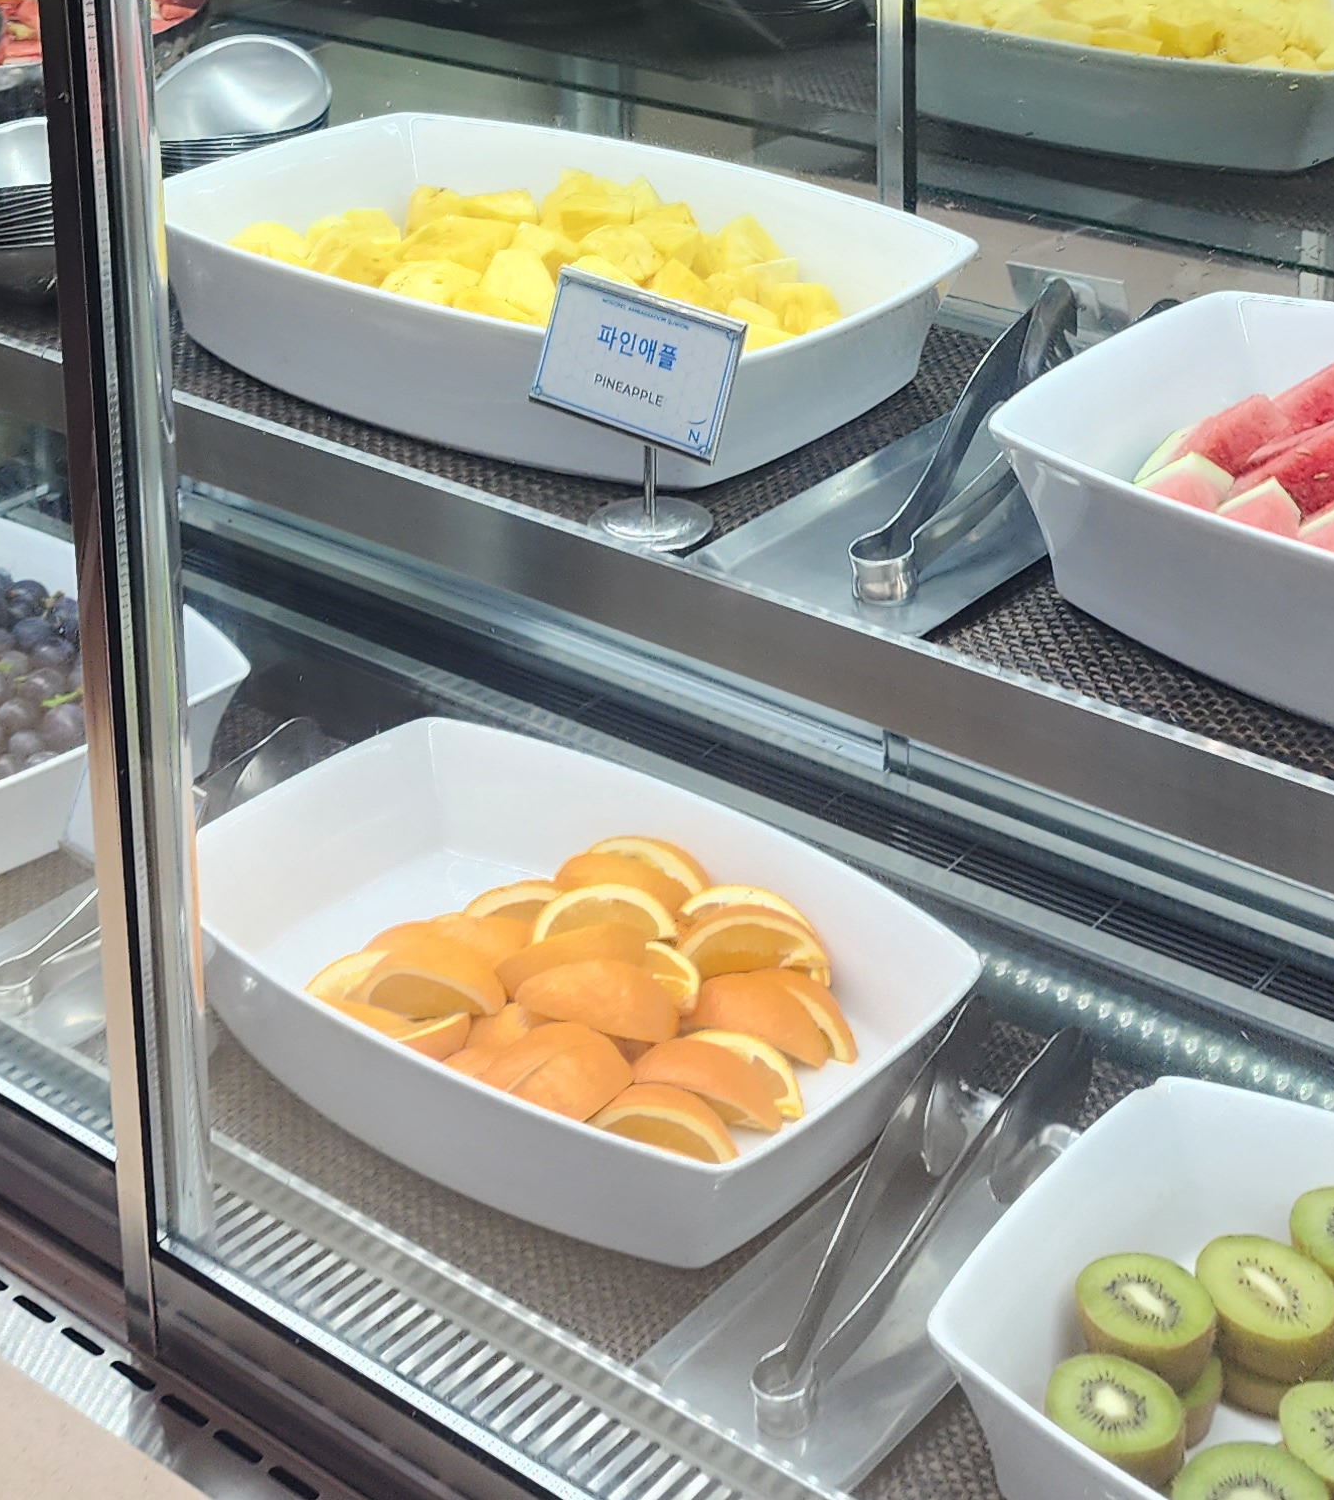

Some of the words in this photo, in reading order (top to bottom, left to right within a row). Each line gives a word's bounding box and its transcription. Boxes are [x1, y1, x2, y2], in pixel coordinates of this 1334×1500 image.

[597, 324, 678, 371] 파인애플
[594, 373, 665, 407] PINEAPPLE
[688, 428, 701, 444] N
